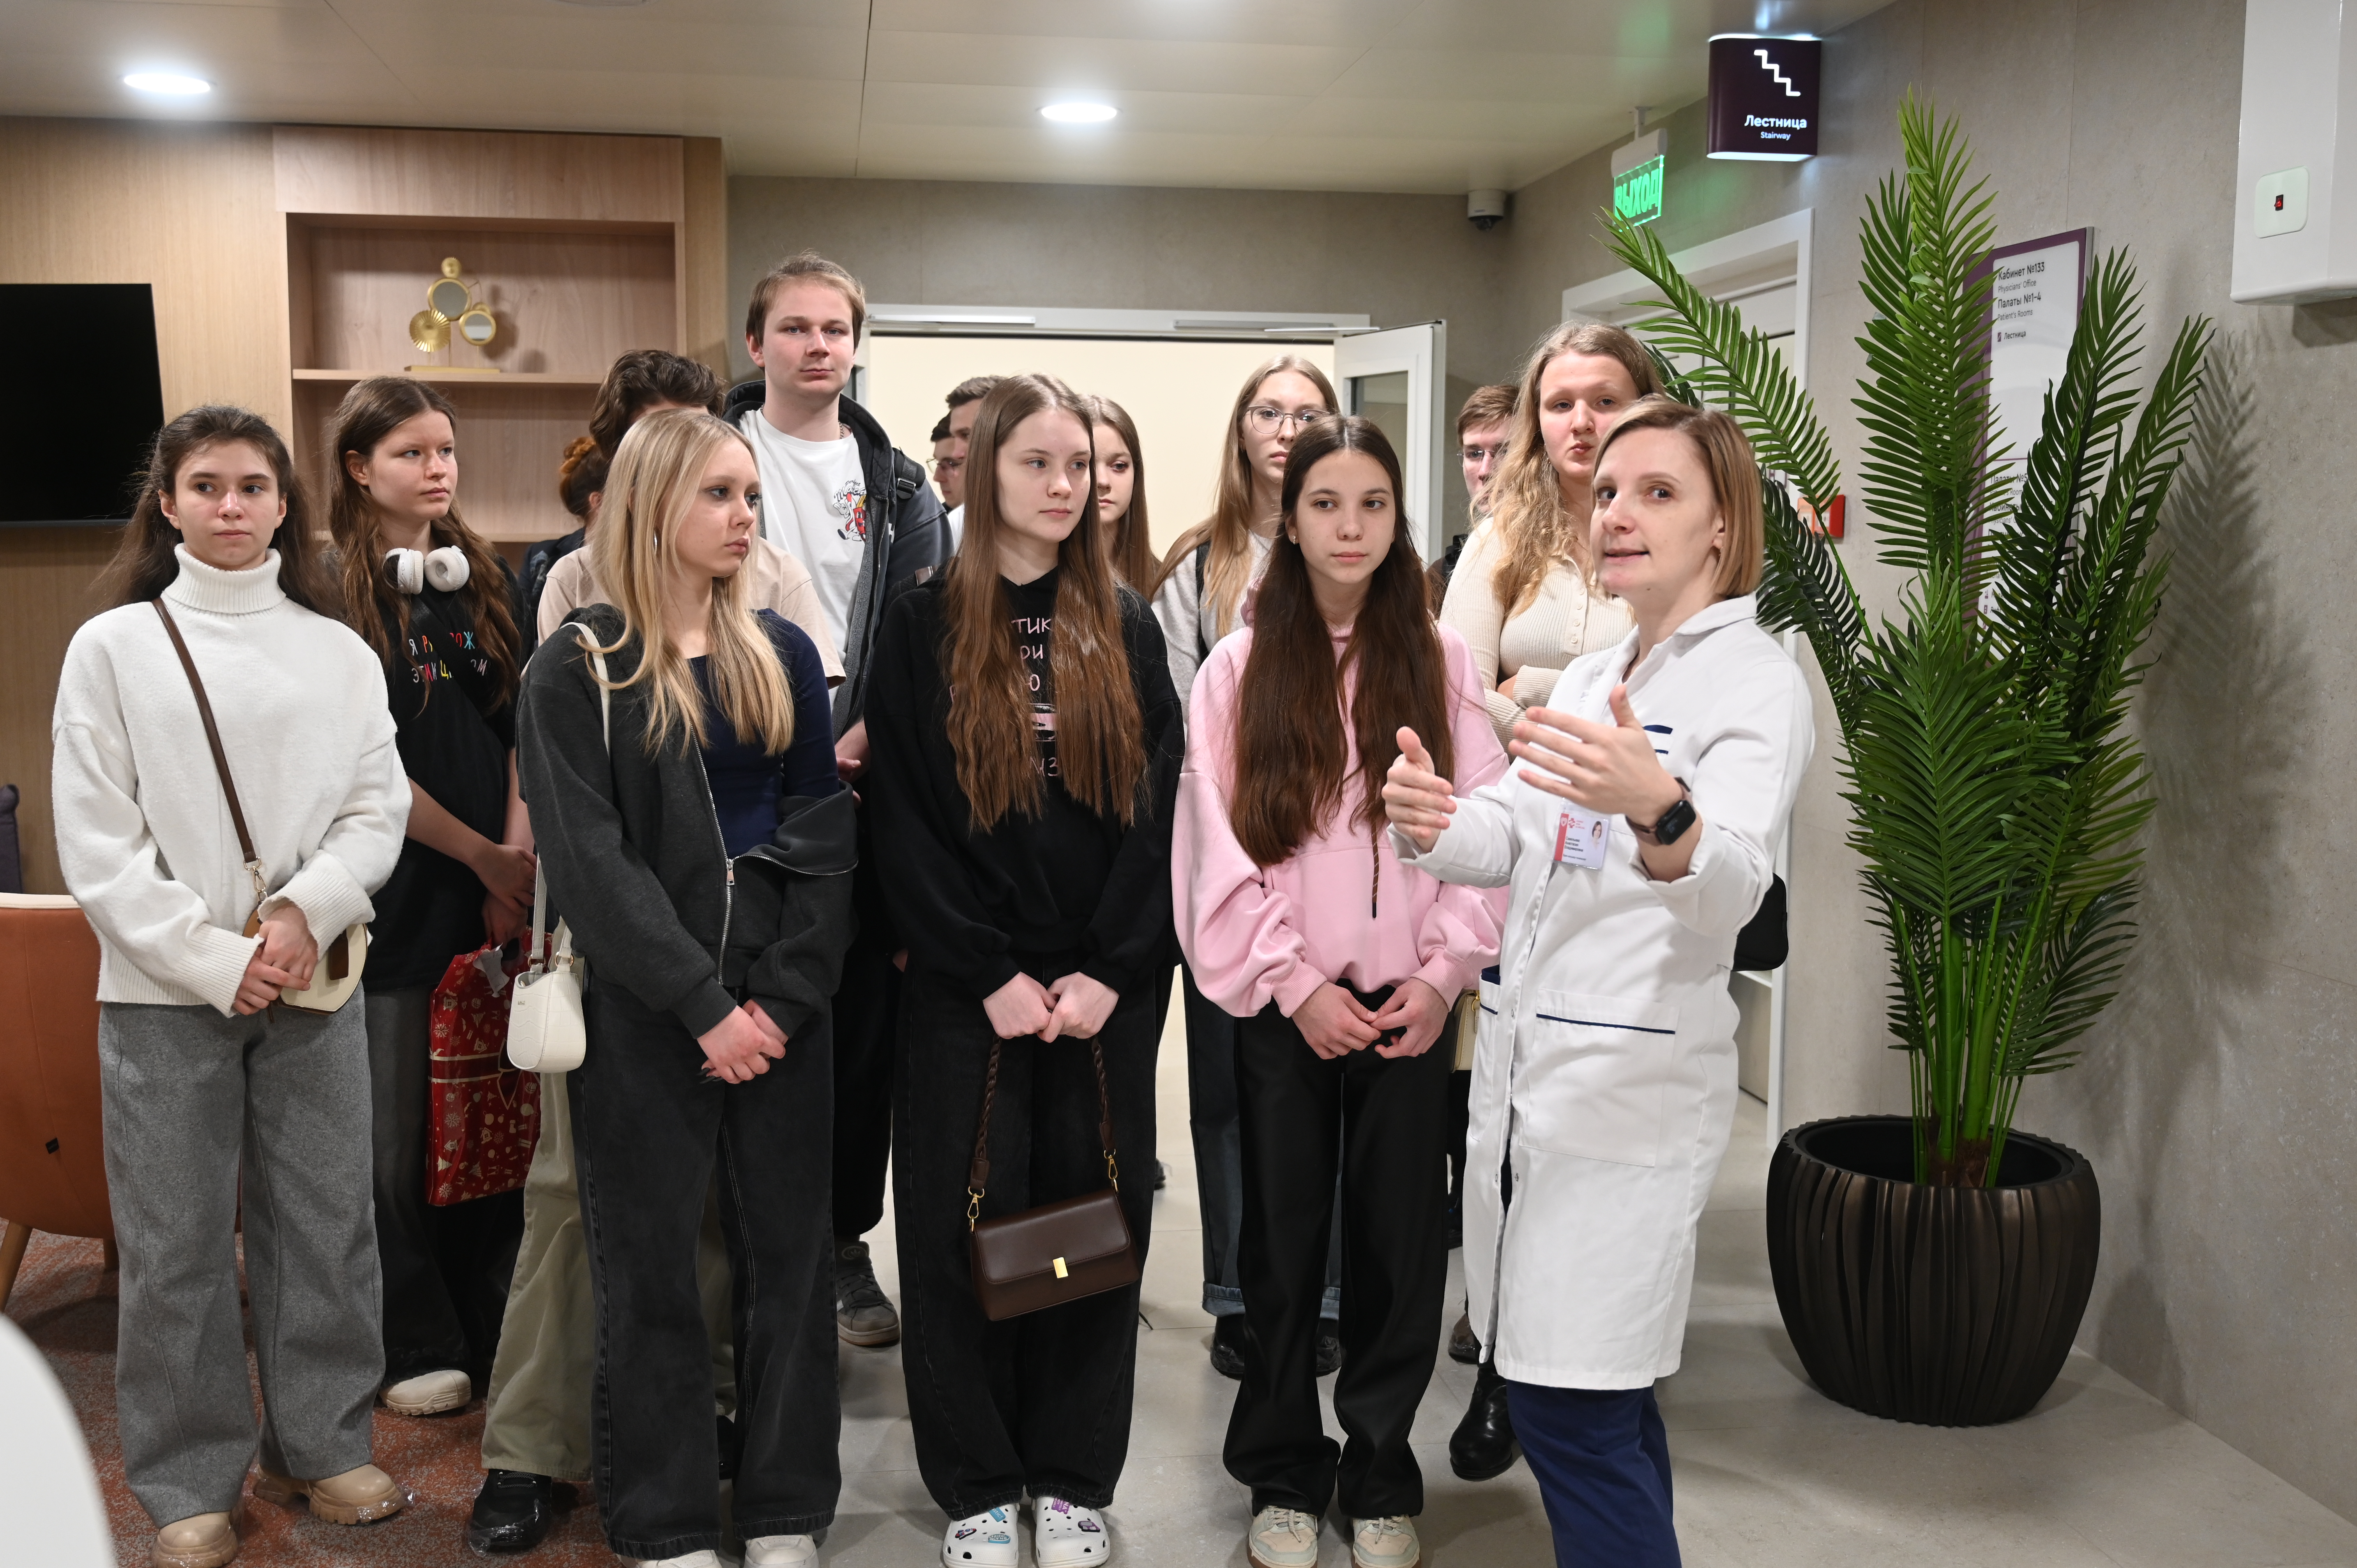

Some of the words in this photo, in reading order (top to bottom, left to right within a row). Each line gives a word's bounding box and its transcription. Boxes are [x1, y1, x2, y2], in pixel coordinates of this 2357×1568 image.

[1744, 115, 1807, 129] Лестница
[1760, 132, 1791, 140] Stairway
[1615, 168, 1659, 221] ВЫХОД
[1998, 268, 2025, 281] Кабинет
[2027, 262, 2044, 274] №133
[1998, 297, 2021, 308] Палаты
[2004, 331, 2026, 340] Лестница
[1991, 475, 2014, 484] Пал
[2017, 473, 2028, 483] №5
[1989, 517, 2012, 525] ysicians'
[1011, 617, 1052, 634] ТИК
[1020, 644, 1043, 669] РИ
